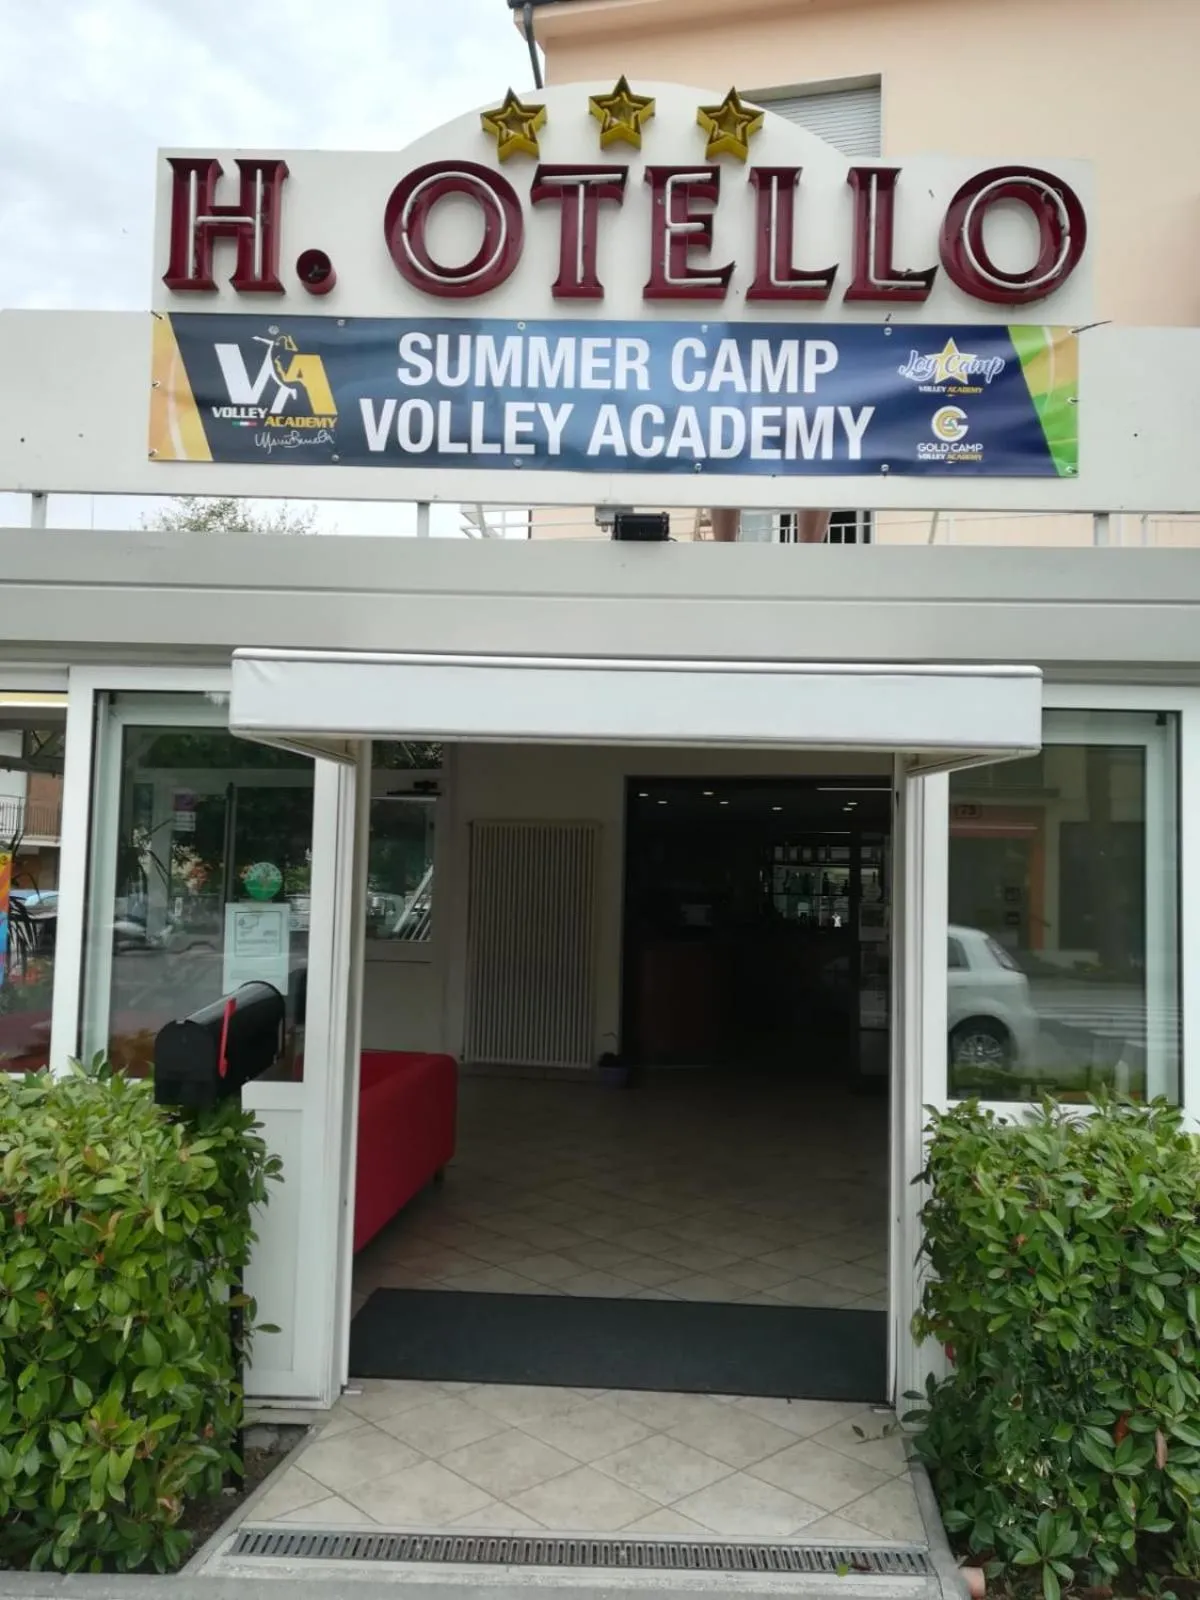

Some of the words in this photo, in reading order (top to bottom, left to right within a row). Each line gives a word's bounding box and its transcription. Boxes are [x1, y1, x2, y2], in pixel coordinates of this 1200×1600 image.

[384, 160, 1088, 306] OTELLO
[397, 332, 651, 391] SUMMER
[671, 337, 839, 394] CAMP
[211, 406, 268, 419] VOLLEY
[264, 415, 338, 429] ACADEMY
[359, 397, 575, 455] VOLLEY
[586, 403, 876, 460] ACADEMY
[916, 443, 949, 453] GOLD
[950, 443, 984, 453] CAMP
